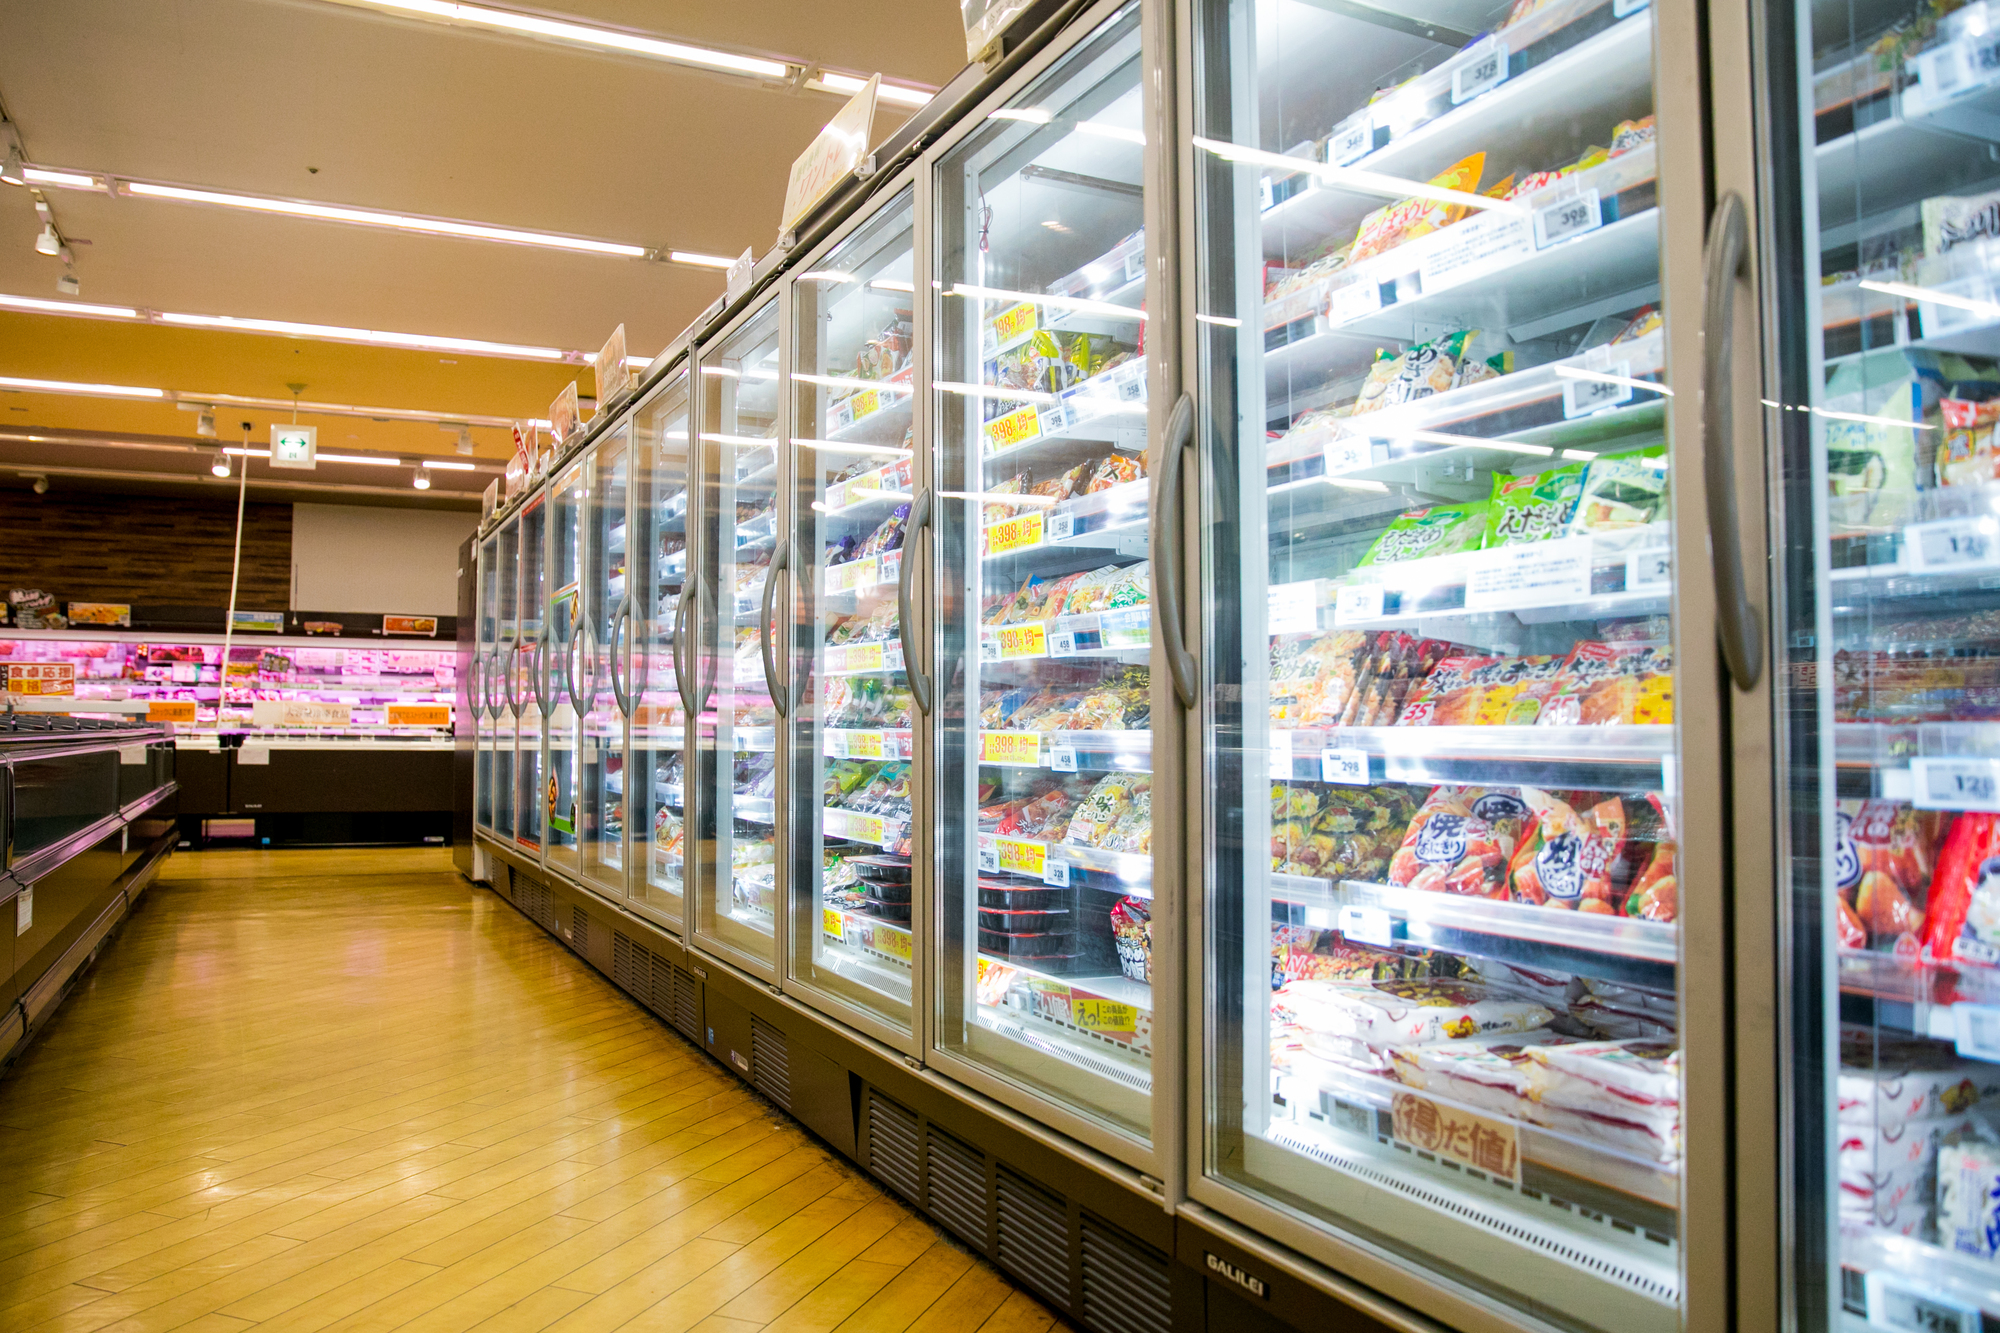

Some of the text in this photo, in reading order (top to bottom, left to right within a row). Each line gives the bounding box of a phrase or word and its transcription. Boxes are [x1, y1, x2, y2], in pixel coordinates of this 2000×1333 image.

[1474, 56, 1498, 80] 378
[1346, 133, 1365, 150] 348
[1561, 206, 1587, 225] 398
[1126, 383, 1140, 396] 258
[1050, 414, 1062, 426] 398
[1058, 520, 1069, 531] 258
[1059, 639, 1070, 649] 458
[1060, 754, 1072, 765] 458
[1341, 761, 1360, 773] 298
[1053, 869, 1064, 879] 328
[1206, 1253, 1264, 1297] GALILEI
